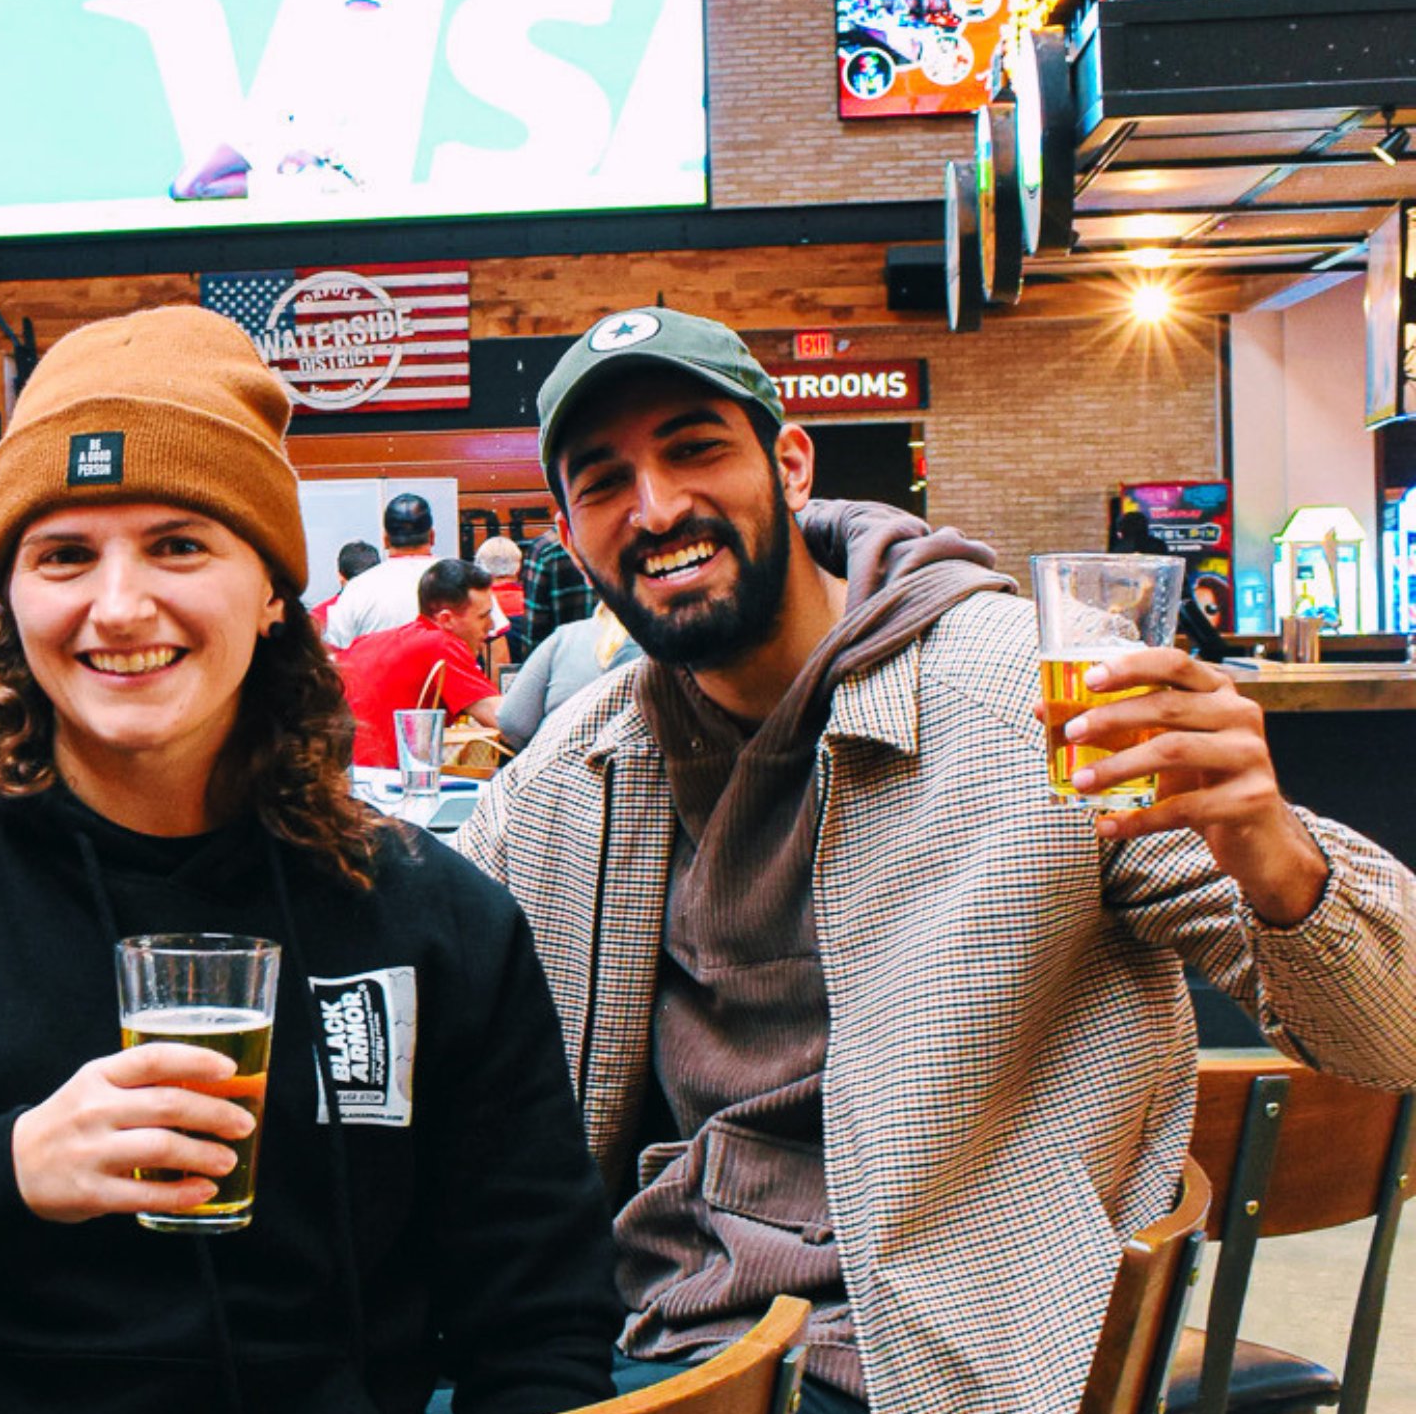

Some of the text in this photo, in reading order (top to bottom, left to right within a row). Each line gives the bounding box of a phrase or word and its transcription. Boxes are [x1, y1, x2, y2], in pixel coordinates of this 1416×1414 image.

[253, 307, 415, 365] WATERSIDE
[801, 335, 829, 356] EXIT
[298, 345, 375, 375] DISTRICT
[769, 371, 908, 399] TROOMS
[78, 451, 86, 463] A
[89, 438, 101, 450] BE
[77, 463, 112, 477] PERSON
[320, 1000, 351, 1083] BLACK
[341, 991, 369, 1083] ARMOR
